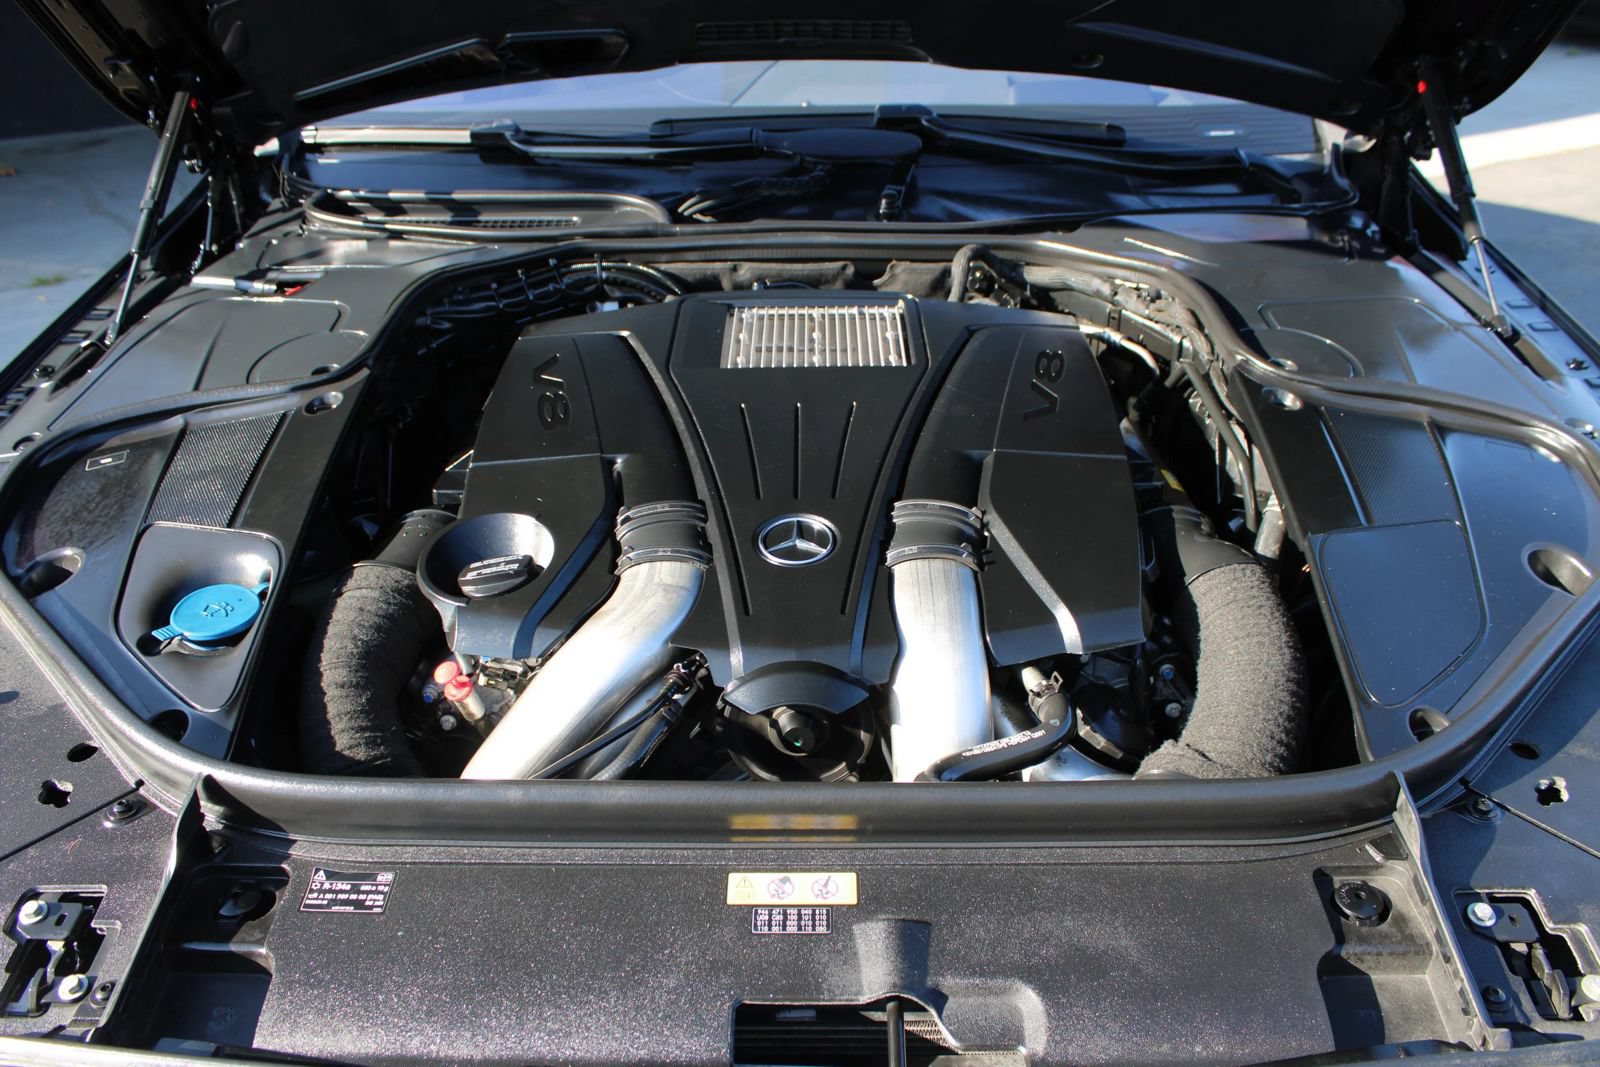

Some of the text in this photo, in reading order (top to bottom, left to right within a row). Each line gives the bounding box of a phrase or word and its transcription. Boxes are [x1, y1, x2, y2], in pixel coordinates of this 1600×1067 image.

[532, 353, 572, 430] V8
[1024, 349, 1065, 421] V8
[322, 882, 351, 890] R-134a
